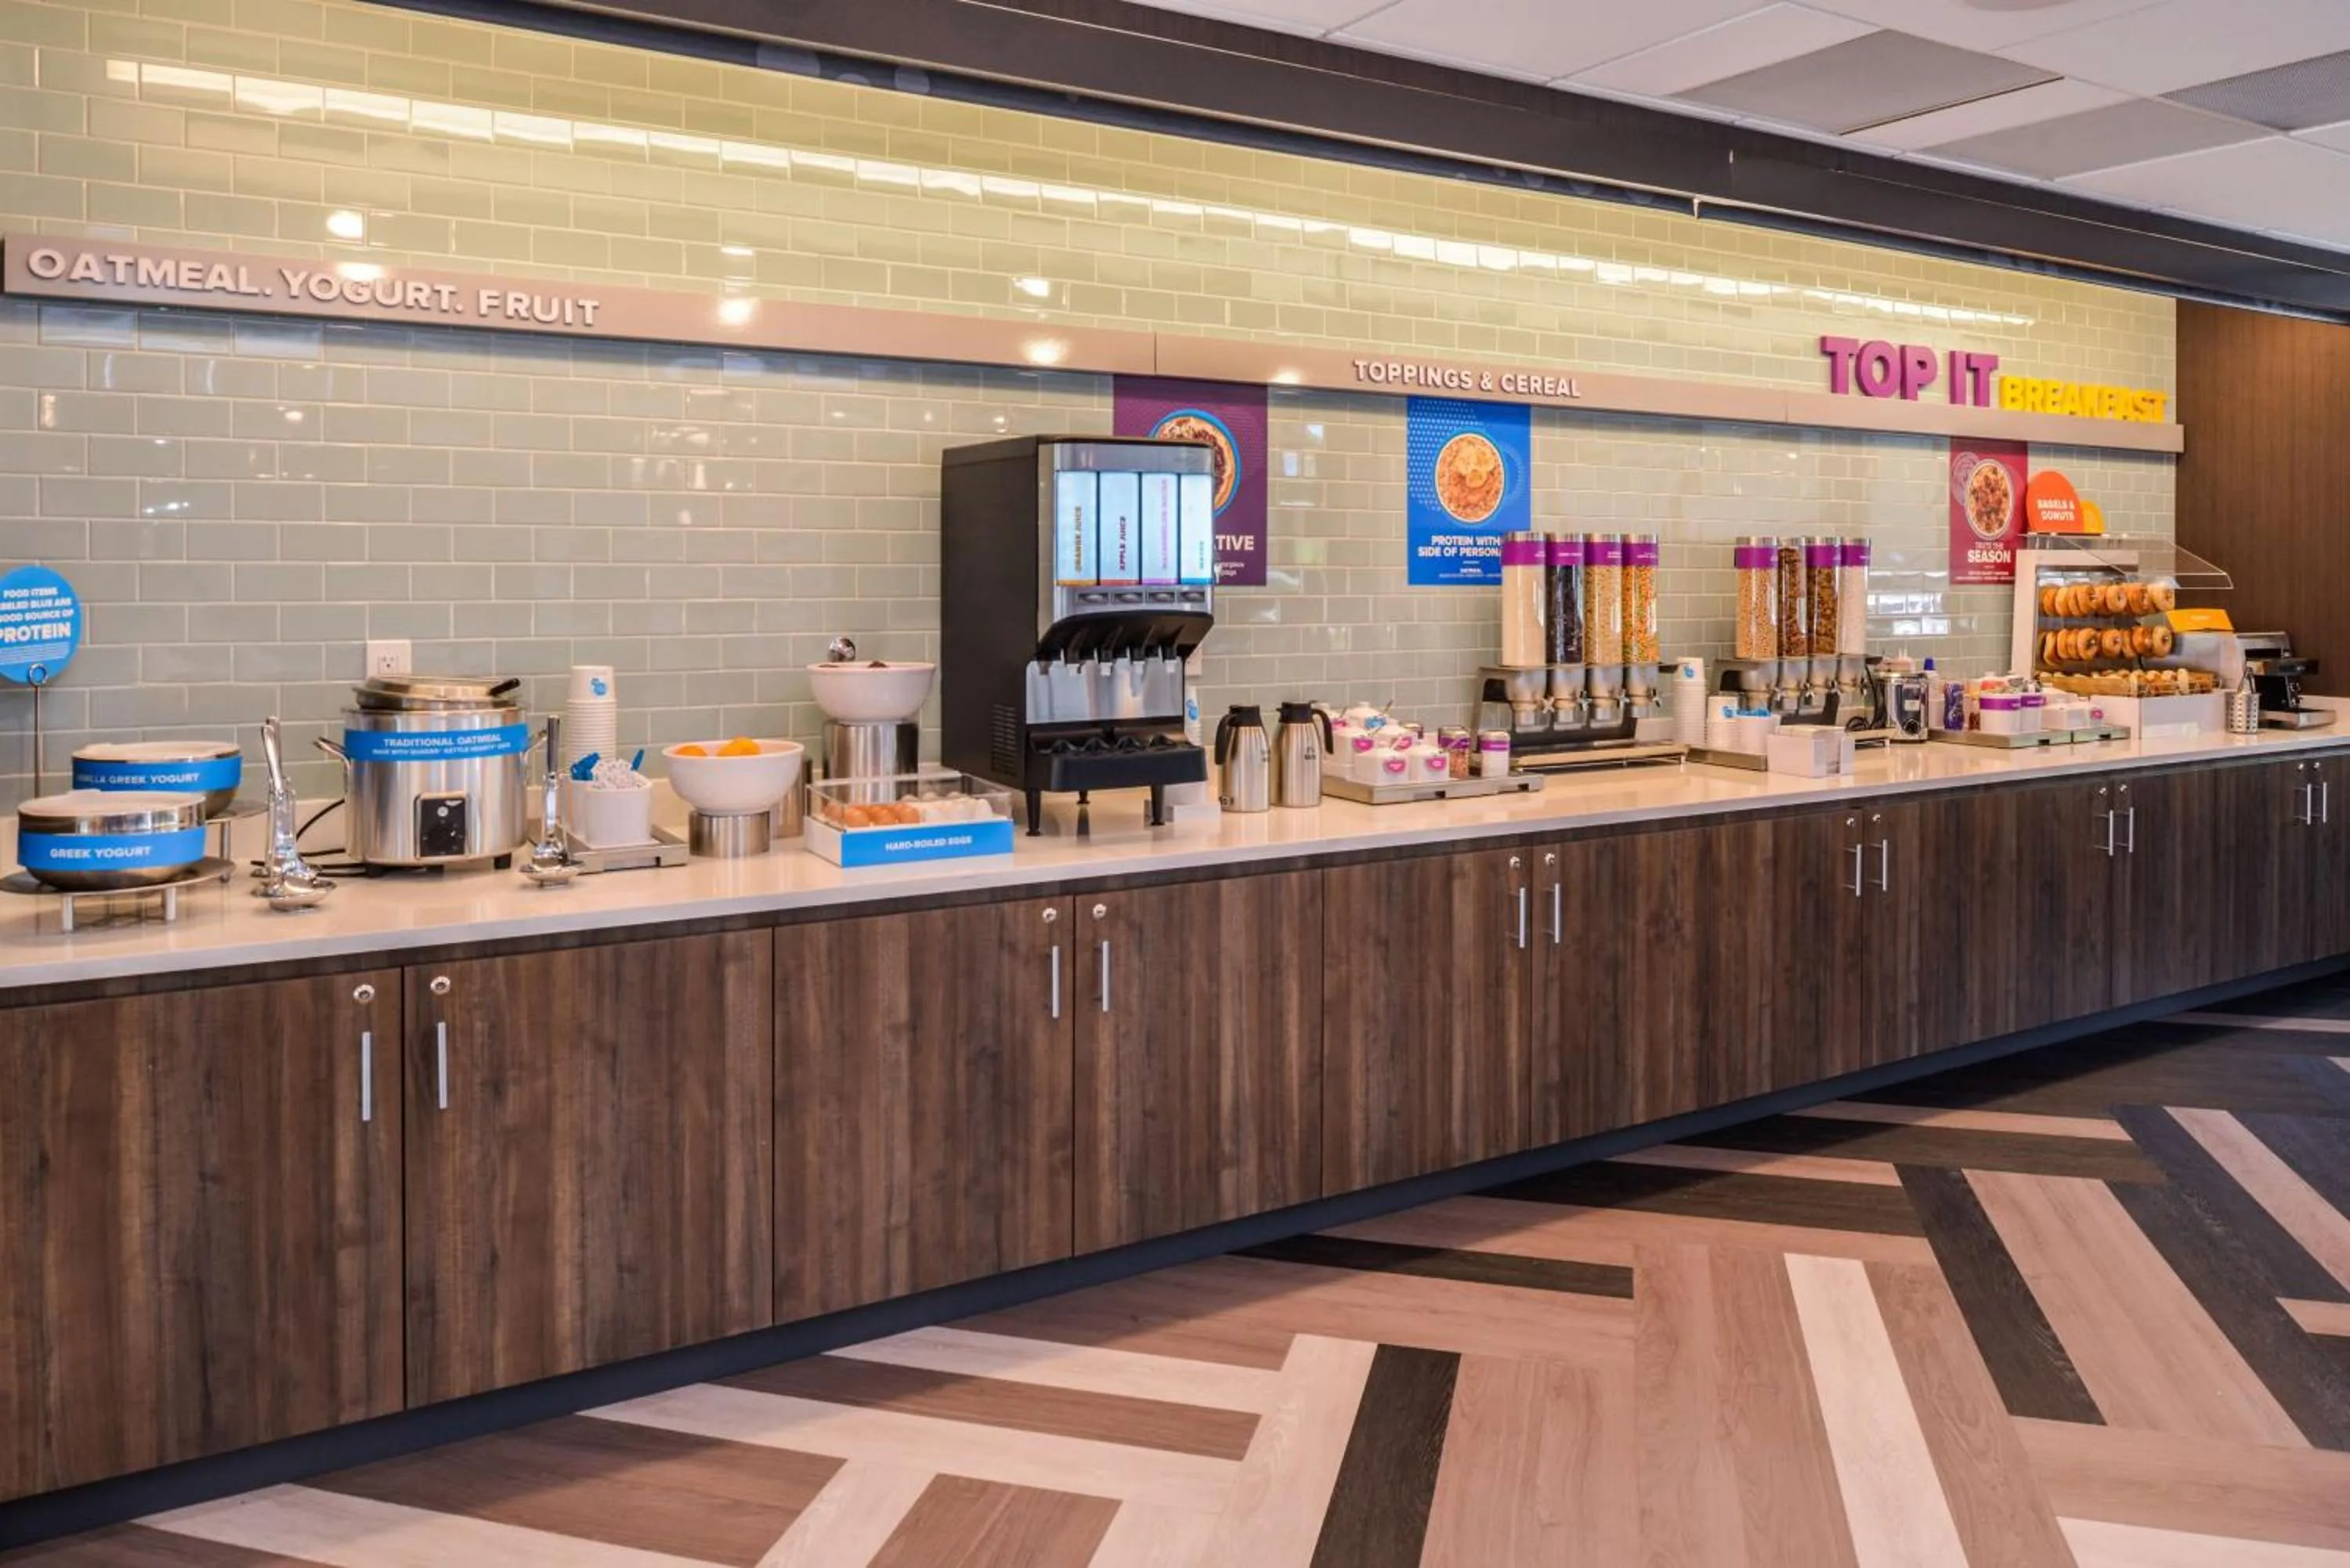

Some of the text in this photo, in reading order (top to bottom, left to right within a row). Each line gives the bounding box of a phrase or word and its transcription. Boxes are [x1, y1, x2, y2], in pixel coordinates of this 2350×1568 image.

[27, 247, 601, 326] OATMEAL. YOGURT. FRUIT
[1820, 335, 1998, 408] TOP IT
[1354, 359, 1582, 399] TOPPINGS & CEREAL
[1999, 375, 2168, 423] BREAKFAST
[2037, 499, 2067, 510] BAGELS
[2041, 510, 2075, 522] DONUTS
[1214, 535, 1254, 551] TIVE
[1431, 535, 1501, 547] PROTEIN WITH
[1418, 546, 1441, 557] SIDE
[1443, 547, 1458, 557] OF
[1967, 550, 2011, 563] SEASON
[384, 733, 501, 747] TRADITIONAL OATMEAL
[109, 775, 146, 784] GREEK
[150, 772, 201, 783] YOGURT
[885, 836, 973, 851] HARD-BOILED EGGS
[50, 846, 152, 859] GREEK YOGURT
